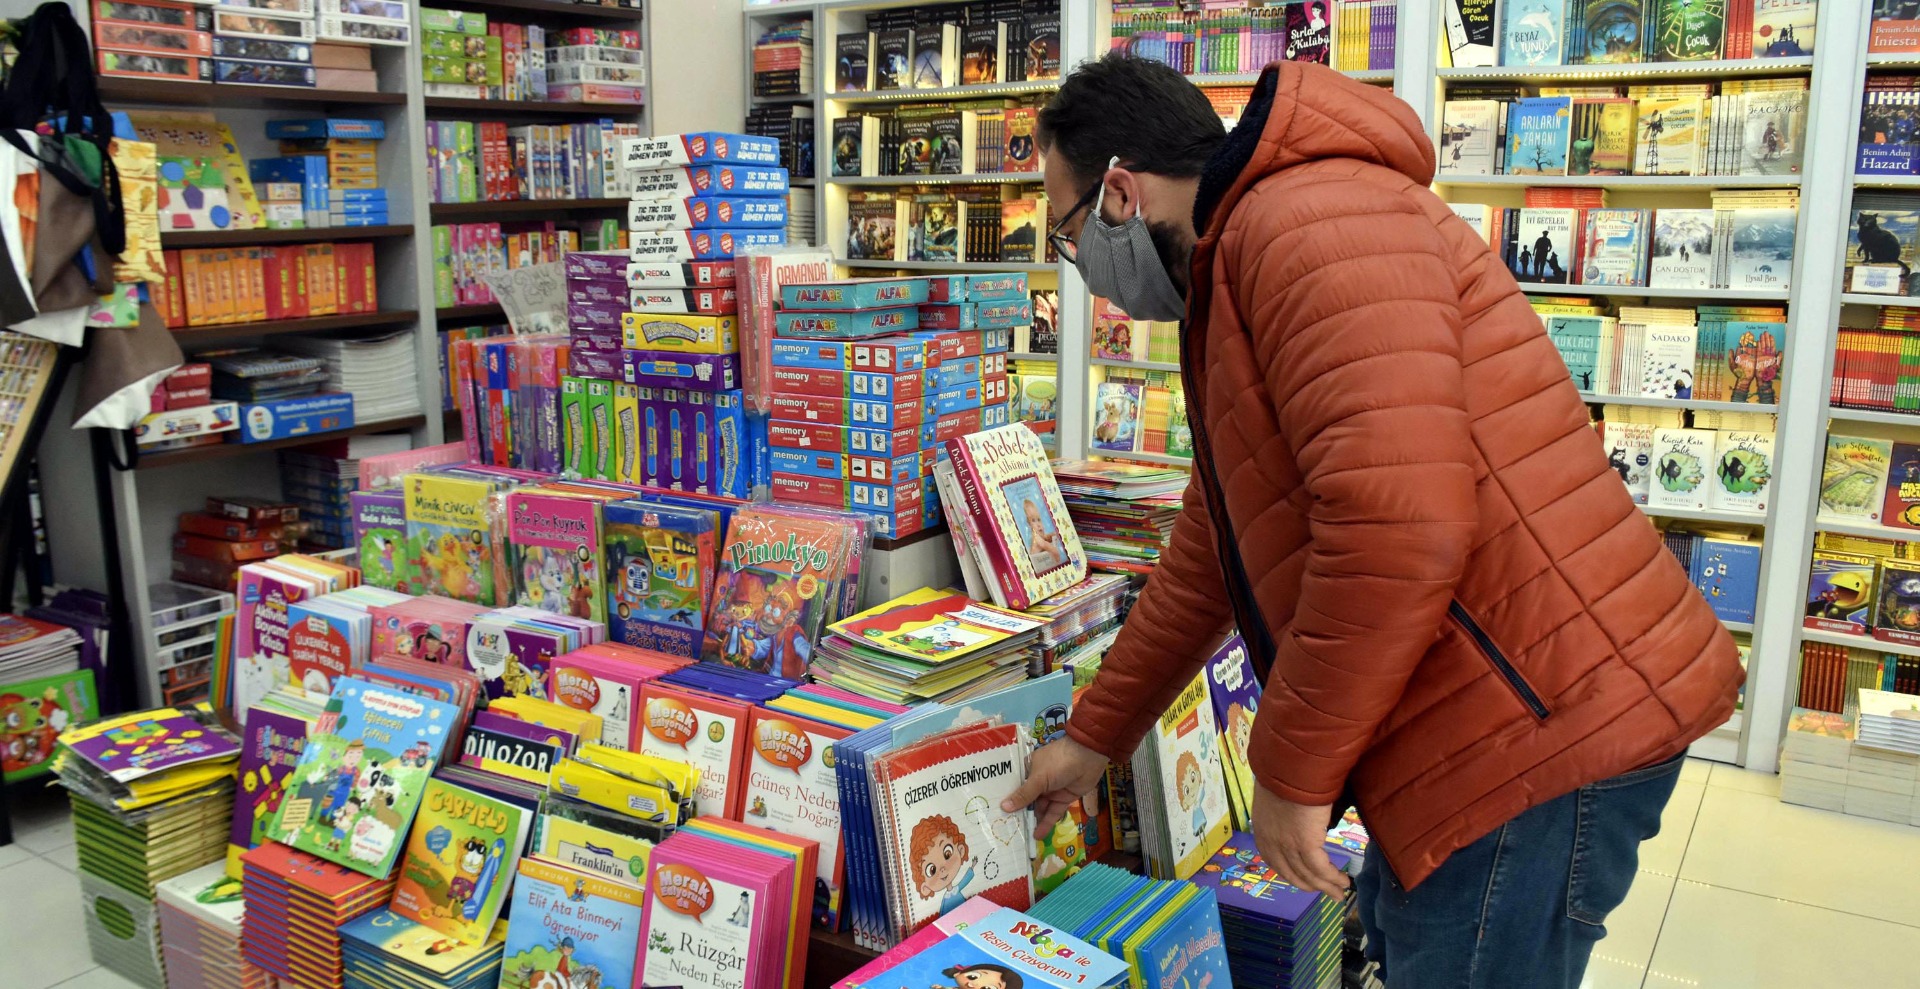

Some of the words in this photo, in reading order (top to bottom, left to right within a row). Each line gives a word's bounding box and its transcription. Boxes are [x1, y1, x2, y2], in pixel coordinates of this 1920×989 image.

[1469, 14, 1489, 22] Çocuk
[1291, 26, 1316, 40] Sırlar
[1514, 31, 1540, 42] BEYAZ
[1876, 26, 1900, 34] Benim
[1520, 40, 1550, 52] YUNUS
[1686, 34, 1710, 50] Çocuk
[1874, 36, 1917, 46] Iniesta
[1521, 115, 1560, 130] ARILARIN
[1523, 132, 1556, 146] ZAMANI
[1863, 148, 1888, 156] Benim
[1890, 149, 1910, 157] Adım
[1862, 158, 1910, 170] Hazard
[776, 262, 828, 284] ORMANDA
[1674, 266, 1706, 274] DOSTUM
[1651, 333, 1690, 342] SADAKO
[774, 344, 810, 354] memory
[898, 344, 919, 352] memory
[1563, 352, 1588, 363] OCUK
[774, 371, 810, 382] memory
[894, 374, 918, 382] memory
[774, 398, 808, 410] memory
[894, 402, 917, 410] memory
[772, 426, 806, 438] memory
[892, 428, 914, 438] memory
[1616, 440, 1651, 448] BALTO
[1662, 434, 1684, 444] Küçük
[1687, 436, 1704, 446] Kara
[982, 431, 1028, 464] Bebek
[773, 450, 808, 464] memory
[892, 456, 914, 466] memory
[952, 448, 968, 477] Bebek
[774, 477, 810, 490] memory
[896, 482, 918, 492] memory
[415, 496, 441, 512] Minik
[962, 478, 981, 516] Albümü
[360, 513, 379, 523] Bale
[898, 508, 918, 518] memory
[552, 514, 588, 533] Kuyruk
[727, 533, 829, 574] Pinokyo
[557, 672, 597, 696] Merak
[560, 685, 596, 704] Ediyorum
[650, 700, 695, 729] Merak
[650, 716, 692, 737] Ediyorum
[664, 728, 676, 738] da
[760, 725, 808, 753] Merak
[465, 733, 549, 774] DİNOZOR
[760, 740, 805, 761] Ediyorum
[776, 752, 788, 762] da
[904, 780, 938, 809] ÇİZEREK
[940, 760, 1012, 792] ÖĞRENİYORUM
[750, 772, 790, 800] Güneş
[795, 785, 840, 812] Neden
[430, 788, 508, 834] GARFIELD
[797, 804, 840, 830] Doğar?
[572, 852, 624, 878] Franklin'in
[539, 868, 571, 883] OKUMA
[659, 870, 710, 900] Merak
[660, 886, 707, 908] Ediyorum
[676, 898, 690, 909] da
[528, 892, 547, 909] Elif
[550, 900, 572, 916] Ata
[576, 906, 624, 932] Binmeyi
[542, 912, 600, 942] Öğreniyor
[1186, 926, 1222, 962] Masallar
[680, 931, 746, 972] Rüzgâr
[980, 930, 1013, 952] Resim
[1011, 949, 1072, 980] Çiziyorum
[1076, 974, 1087, 984] 1
[1074, 956, 1091, 967] ile
[669, 958, 708, 983] Neden
